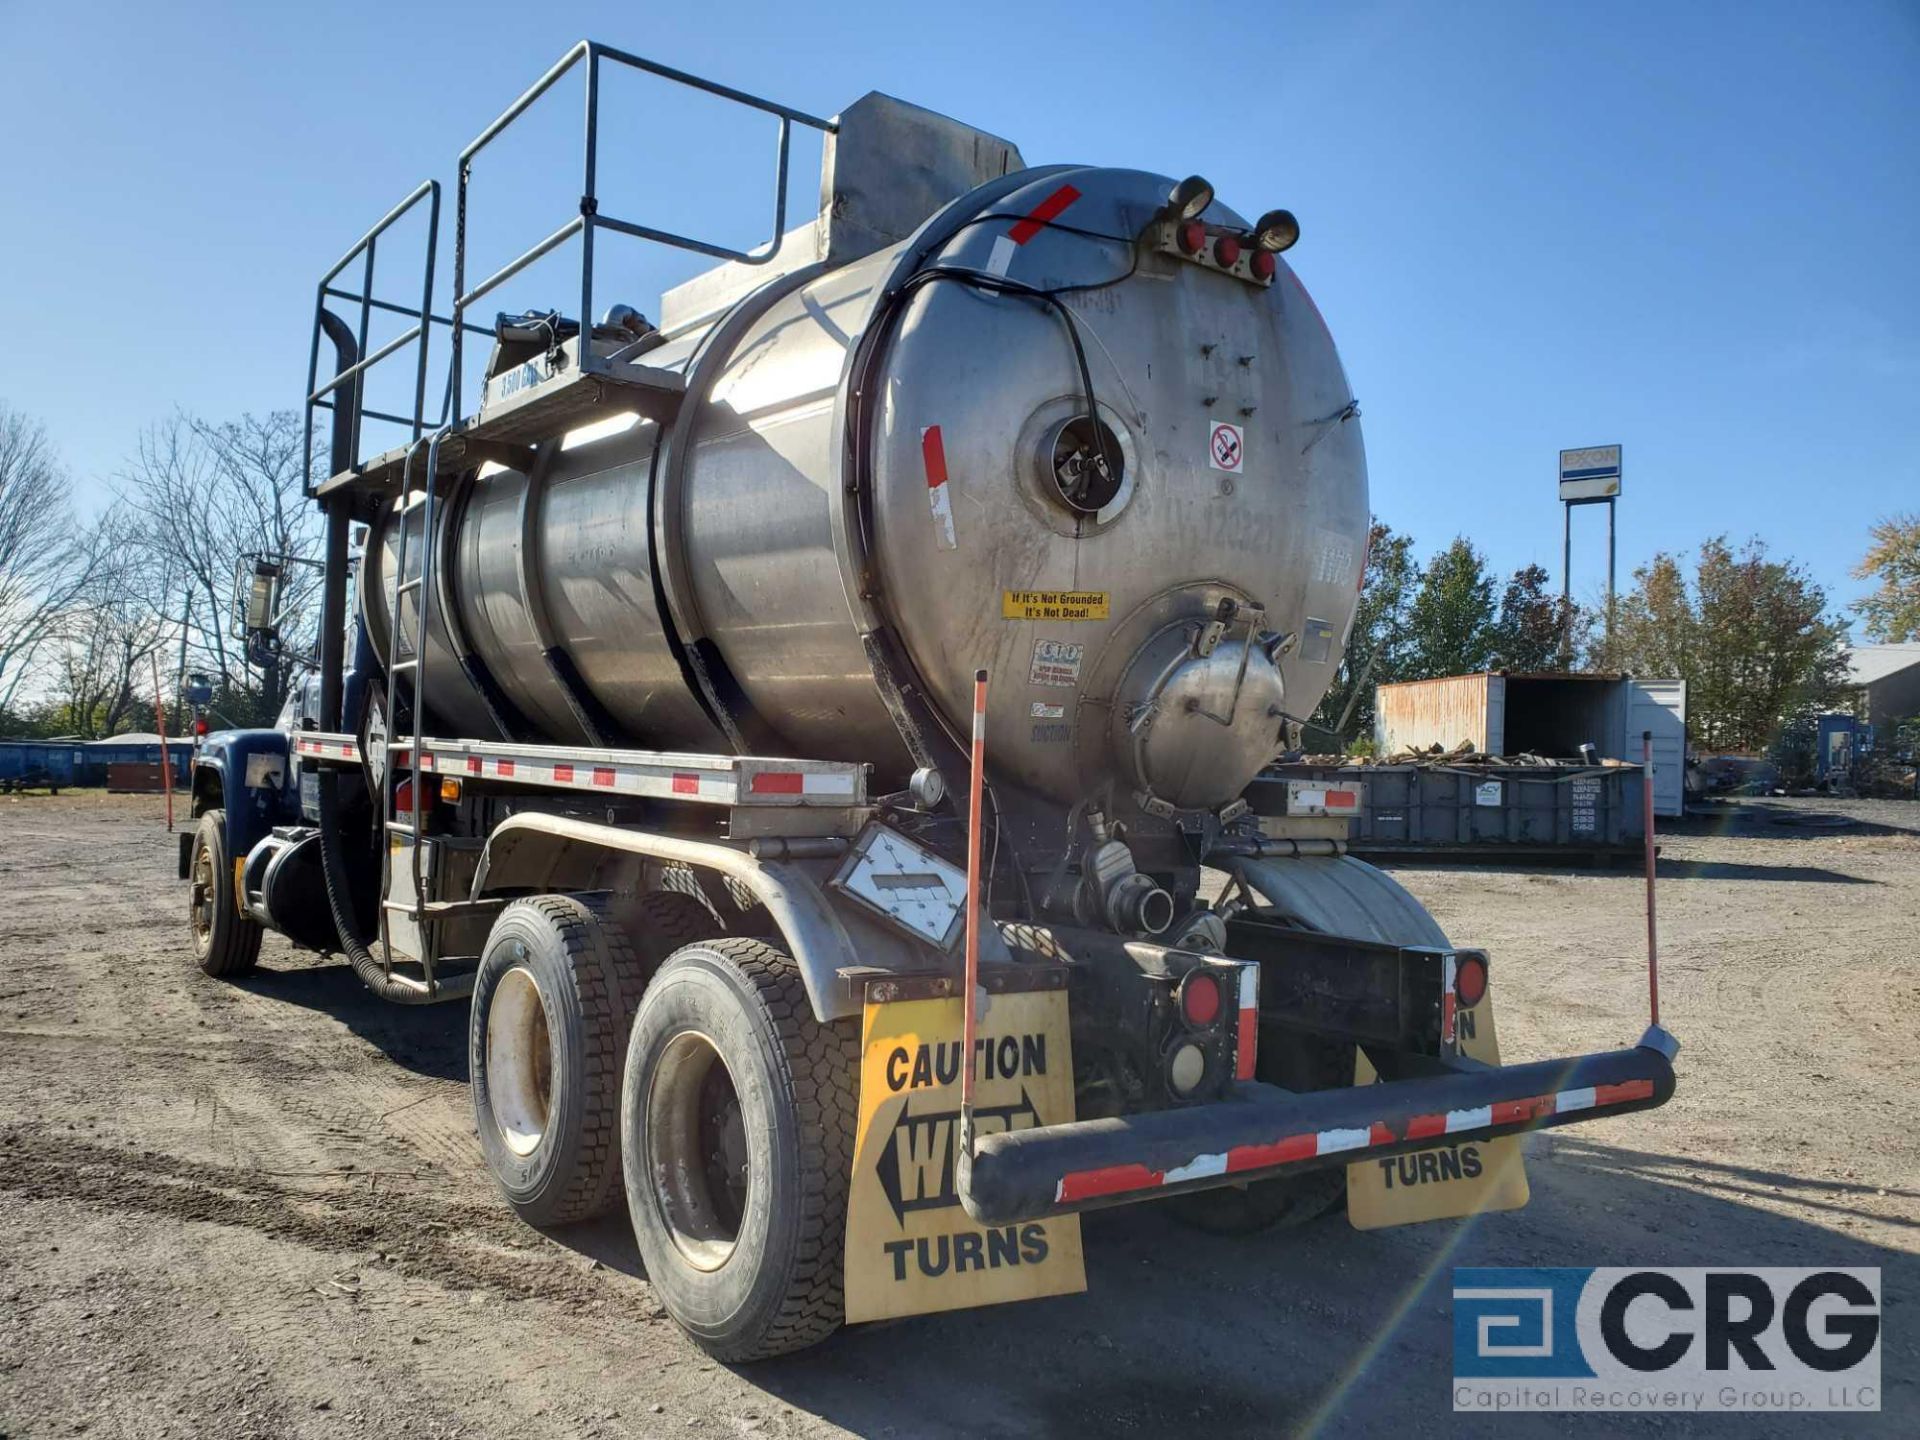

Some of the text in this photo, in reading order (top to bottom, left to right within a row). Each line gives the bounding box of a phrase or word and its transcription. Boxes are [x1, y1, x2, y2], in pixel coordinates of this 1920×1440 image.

[1562, 449, 1617, 468] EXXON
[1011, 593, 1104, 605] If It's Not Grounded
[1025, 607, 1089, 618] It's Not Dead!
[1378, 1146, 1483, 1189] TURNS
[883, 1223, 1049, 1281] TURNS
